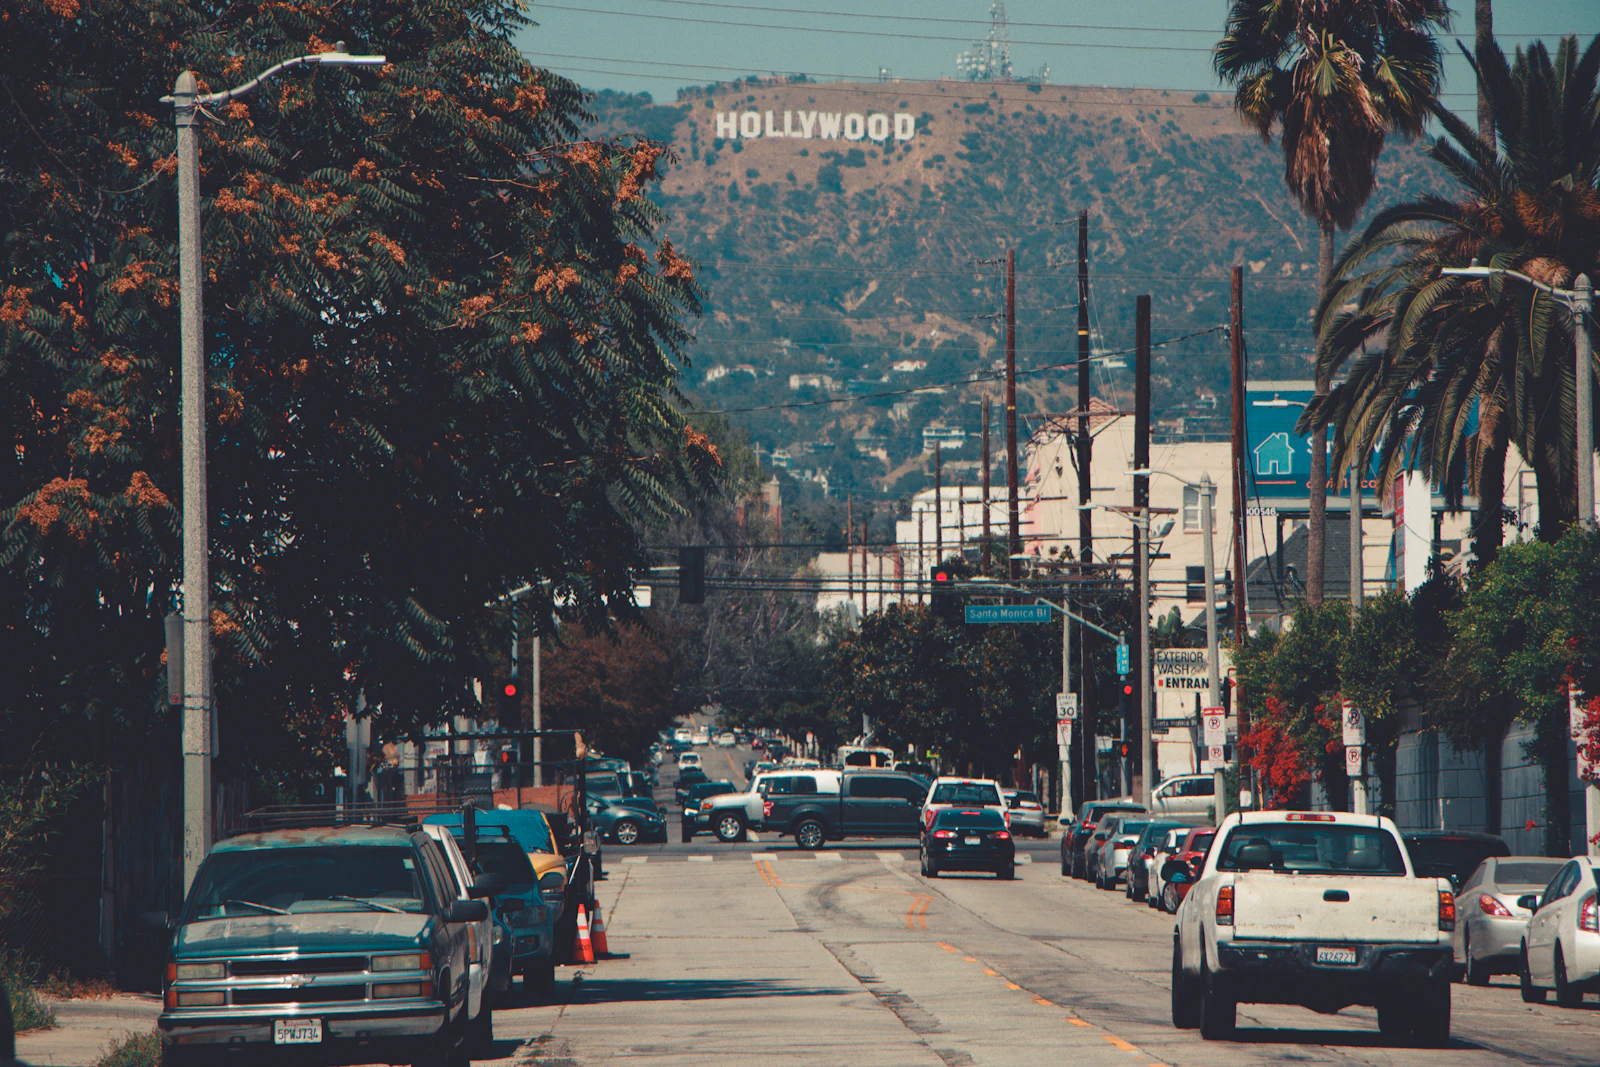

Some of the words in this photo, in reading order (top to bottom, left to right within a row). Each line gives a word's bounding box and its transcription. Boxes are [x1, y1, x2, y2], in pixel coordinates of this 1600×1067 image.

[716, 110, 915, 140] HOLLYWOOD
[970, 609, 998, 619] Santa
[1000, 608, 1034, 618] Monica
[1036, 608, 1047, 617] Bl
[1156, 651, 1204, 662] EXTERIOR
[1157, 664, 1189, 675] WASH
[1059, 707, 1075, 717] 30
